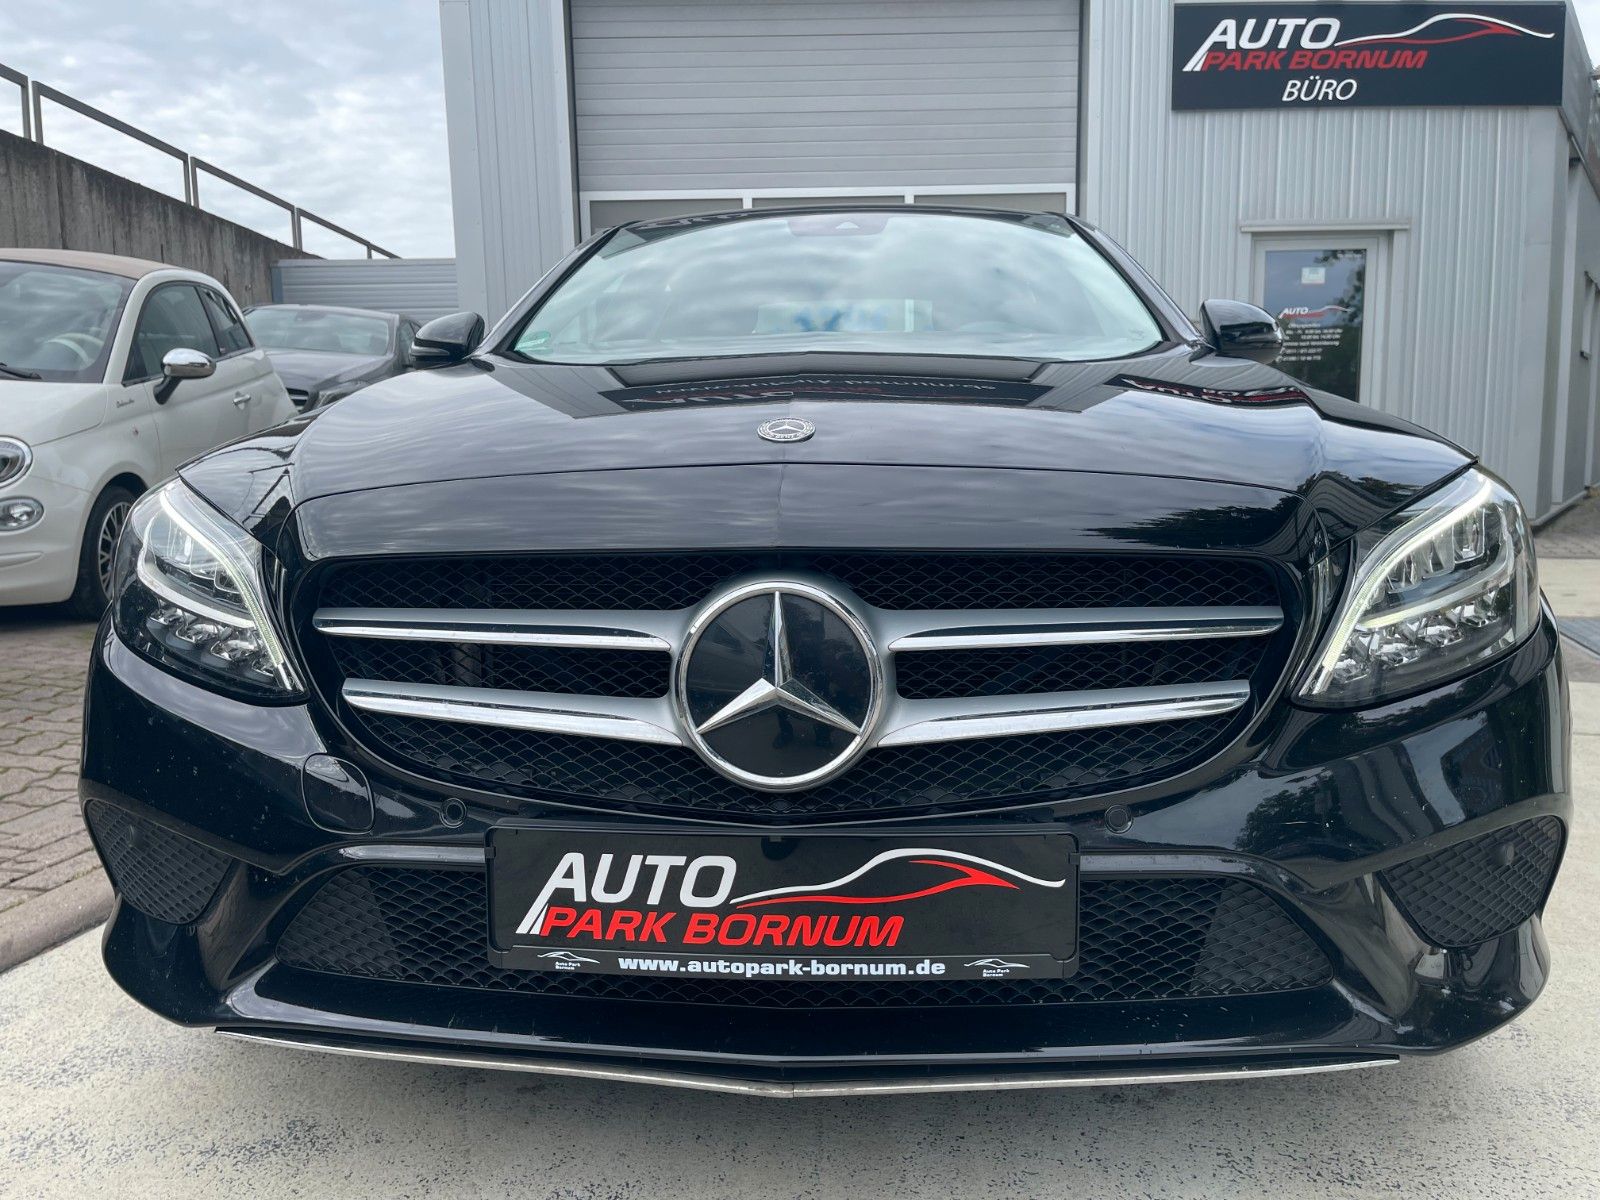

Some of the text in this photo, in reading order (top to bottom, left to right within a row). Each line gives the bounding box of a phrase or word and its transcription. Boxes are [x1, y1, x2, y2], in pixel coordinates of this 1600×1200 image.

[1182, 17, 1341, 72] AUTO
[1201, 50, 1428, 72] PARK BORNUM
[1281, 75, 1358, 102] BÜRO
[1279, 306, 1309, 319] AUTO
[515, 852, 737, 935] AUTO
[539, 906, 905, 947] PARK BORNUM
[617, 957, 946, 978] www.autopark-bornum.de
